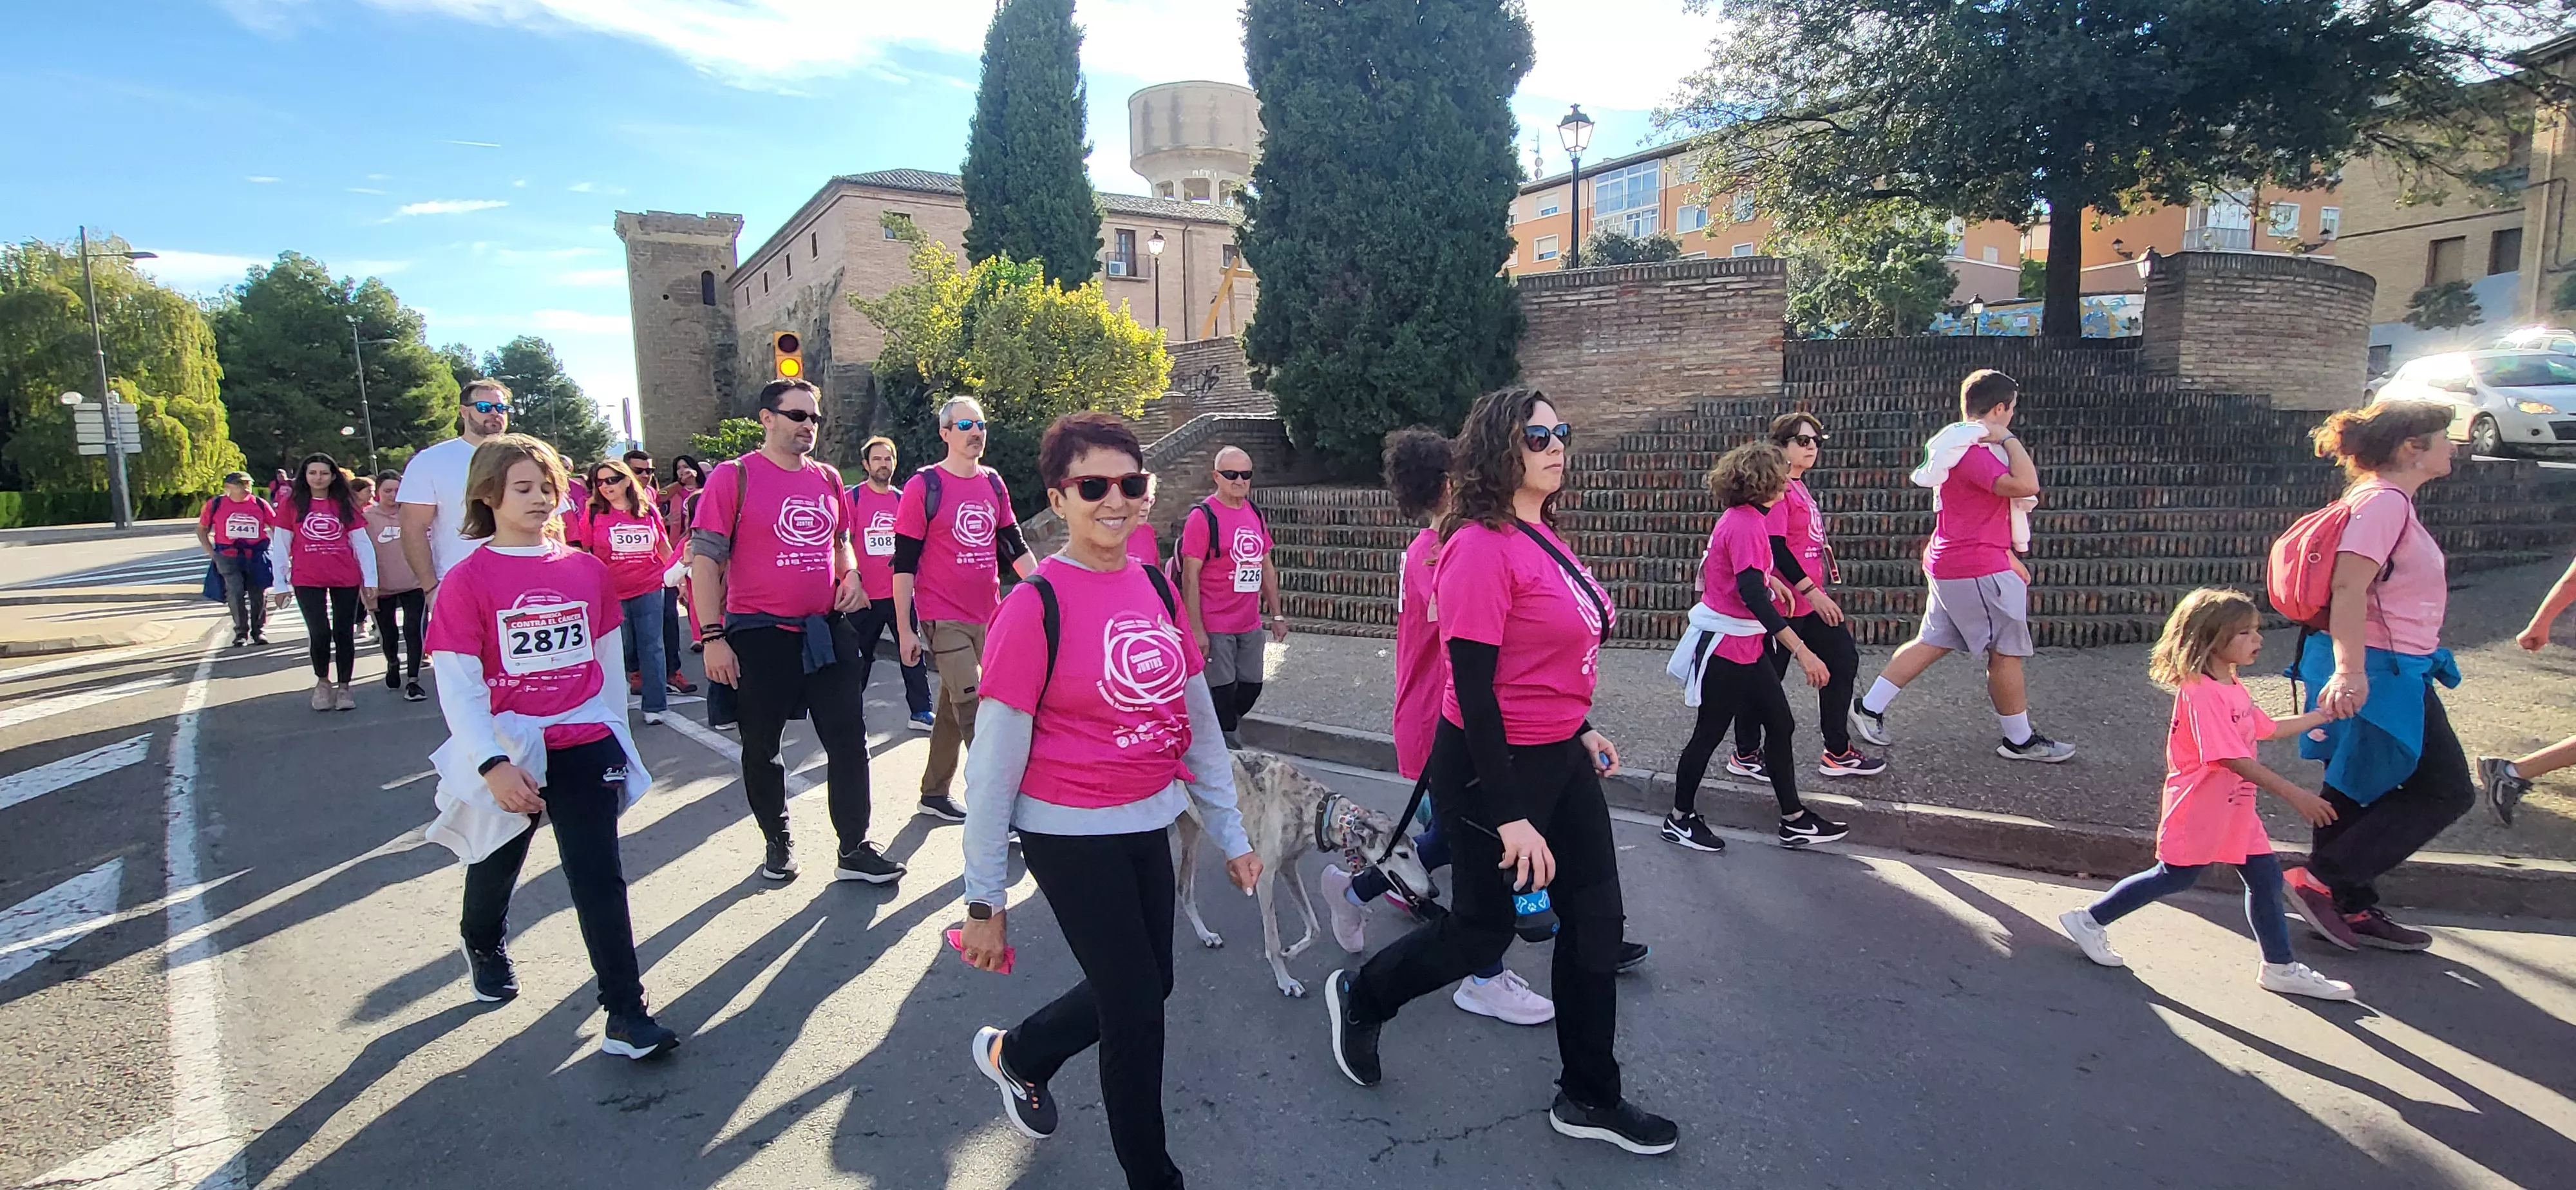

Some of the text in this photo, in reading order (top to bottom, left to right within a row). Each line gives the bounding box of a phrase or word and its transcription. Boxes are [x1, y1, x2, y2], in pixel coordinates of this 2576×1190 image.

[229, 525, 255, 533] 2441
[616, 534, 649, 544] 3091
[511, 619, 547, 628] CONTRA
[511, 623, 583, 655] 2873
